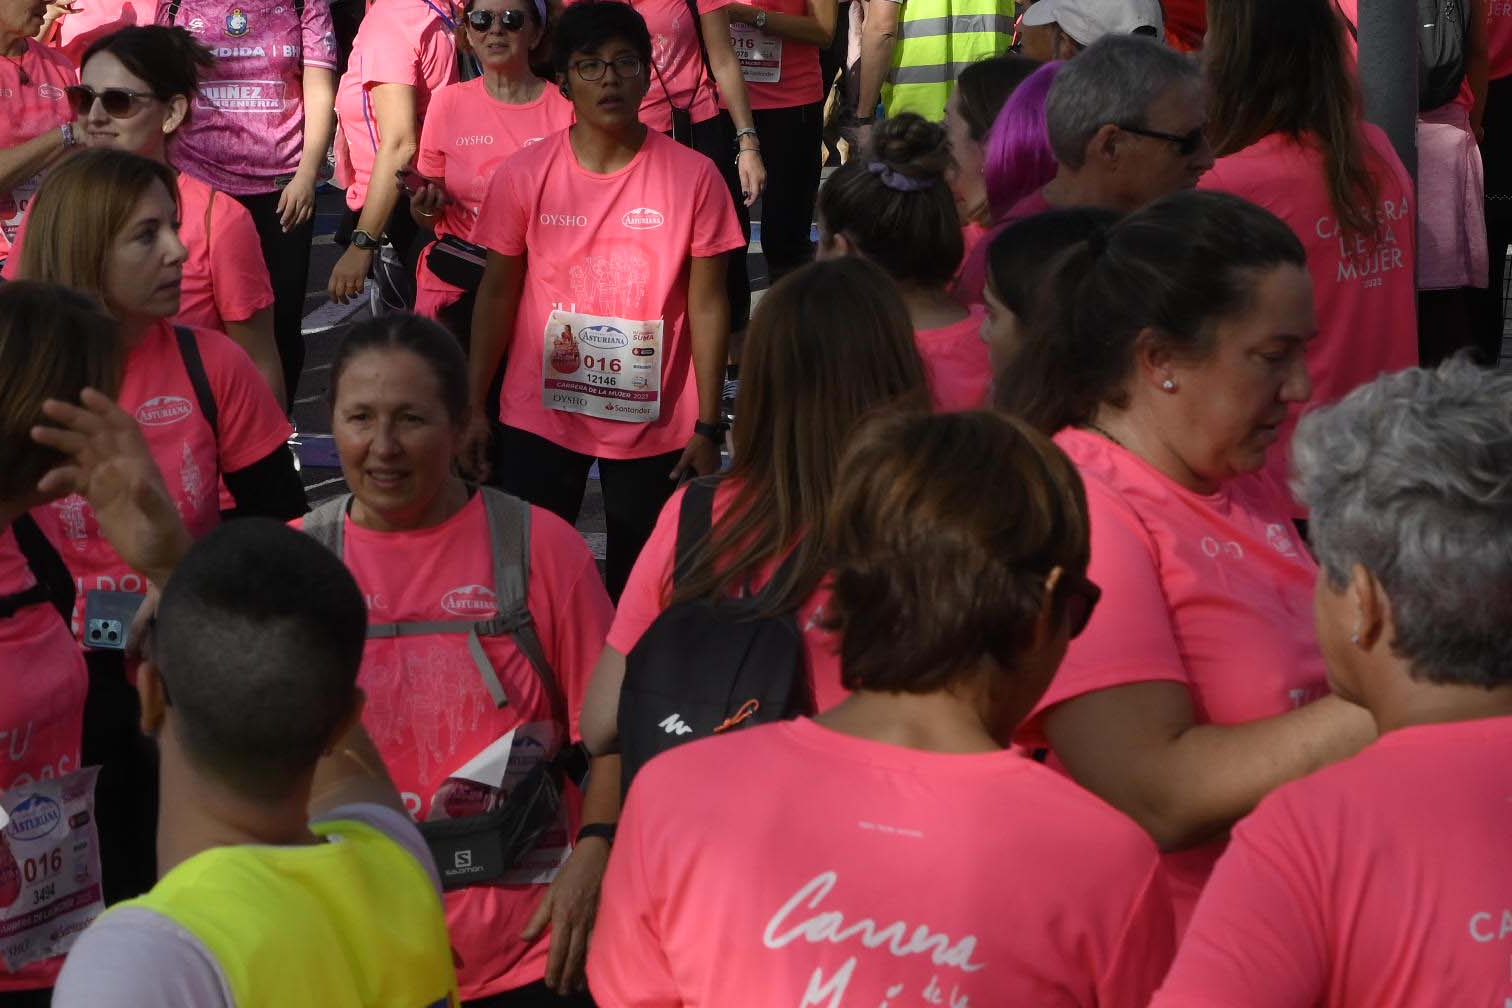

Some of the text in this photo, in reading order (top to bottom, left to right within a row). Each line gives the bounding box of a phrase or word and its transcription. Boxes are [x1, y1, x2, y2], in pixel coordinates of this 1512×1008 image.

[539, 213, 588, 228] OYSHO
[624, 214, 662, 225] ASTURIANA
[1336, 248, 1404, 284] MUJER
[583, 332, 626, 346] ASTURIANA
[583, 355, 622, 373] 016
[586, 373, 617, 386] 12146
[556, 382, 588, 392] CARRERA
[608, 390, 632, 398] MUJER
[553, 393, 651, 414] OYSHO Santander
[11, 811, 59, 835] ASTURIANA
[23, 847, 63, 883] 016
